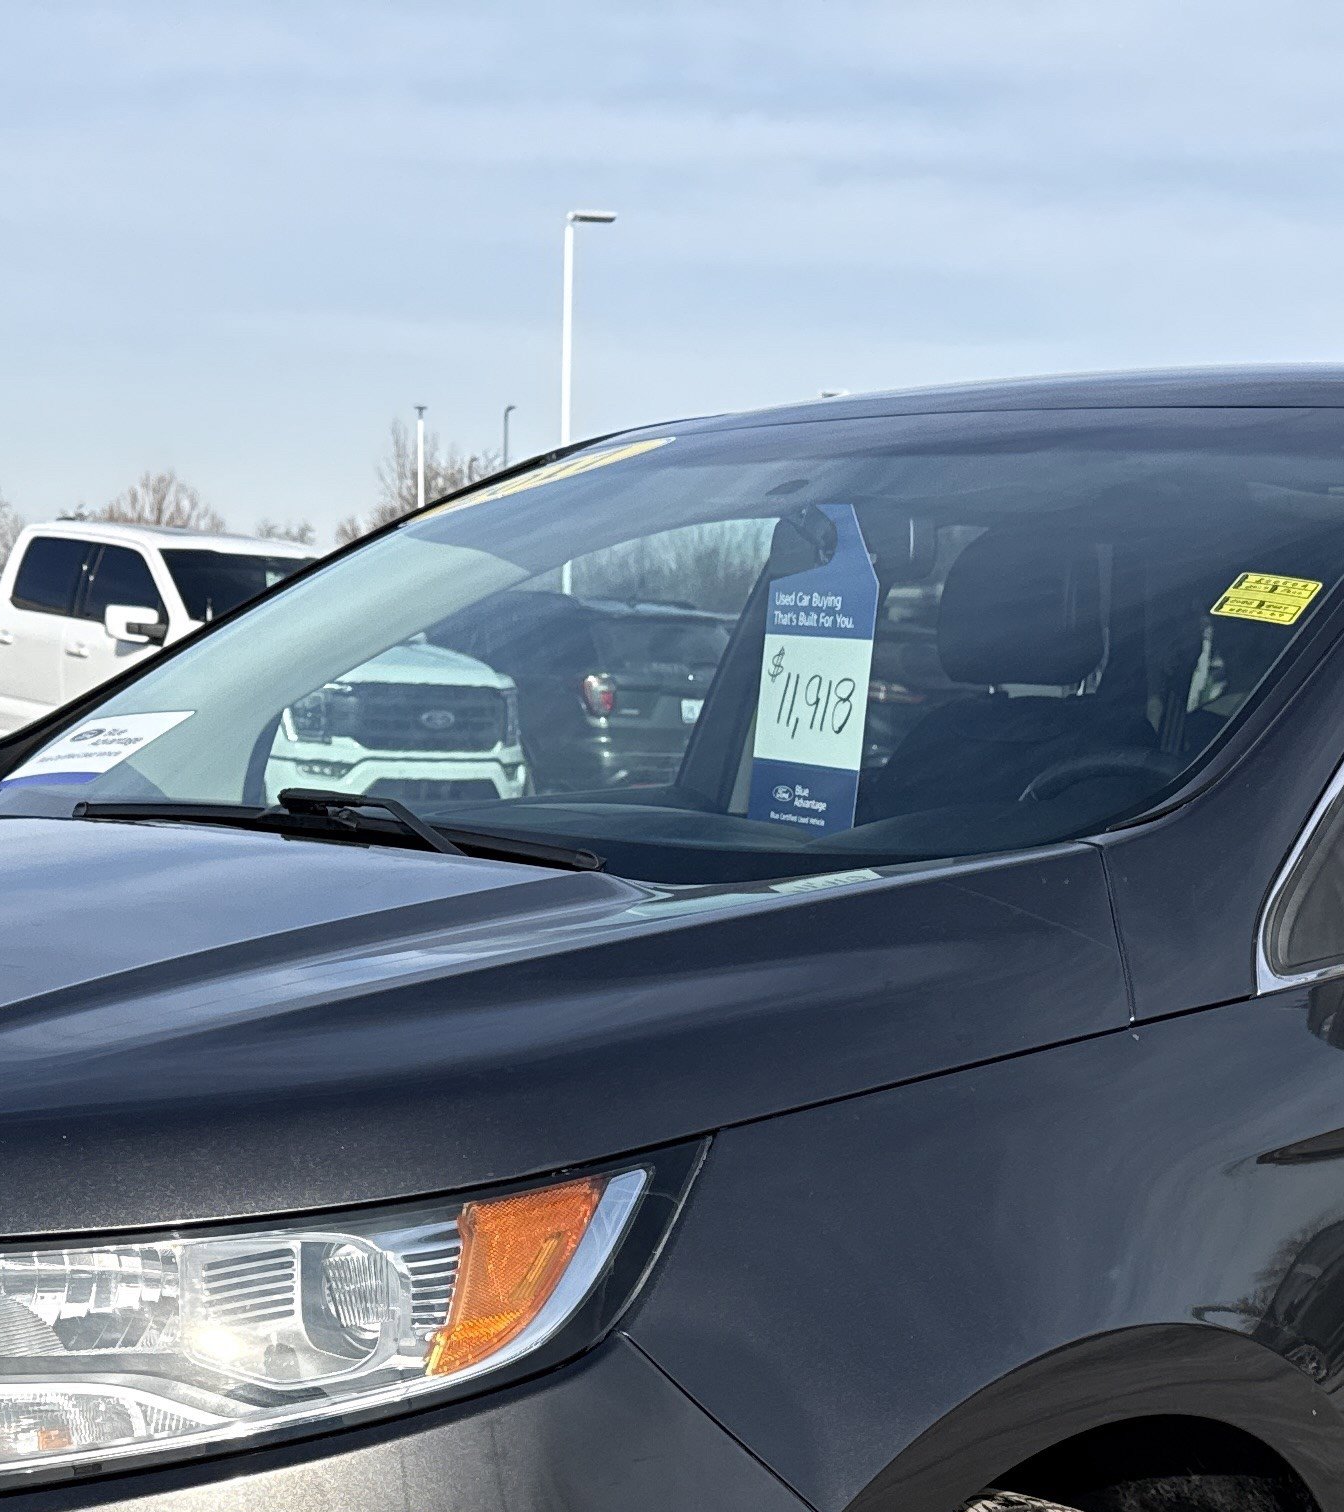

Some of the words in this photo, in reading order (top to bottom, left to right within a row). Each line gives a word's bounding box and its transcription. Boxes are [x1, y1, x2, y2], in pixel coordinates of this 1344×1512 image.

[775, 592, 795, 606] Used
[796, 592, 811, 607] Car
[812, 592, 843, 611] Buying
[774, 611, 796, 626] That's
[798, 611, 817, 627] Built
[819, 612, 834, 628] For
[836, 613, 854, 629] You.
[794, 784, 810, 797] Blue
[793, 797, 827, 813] Advantage
